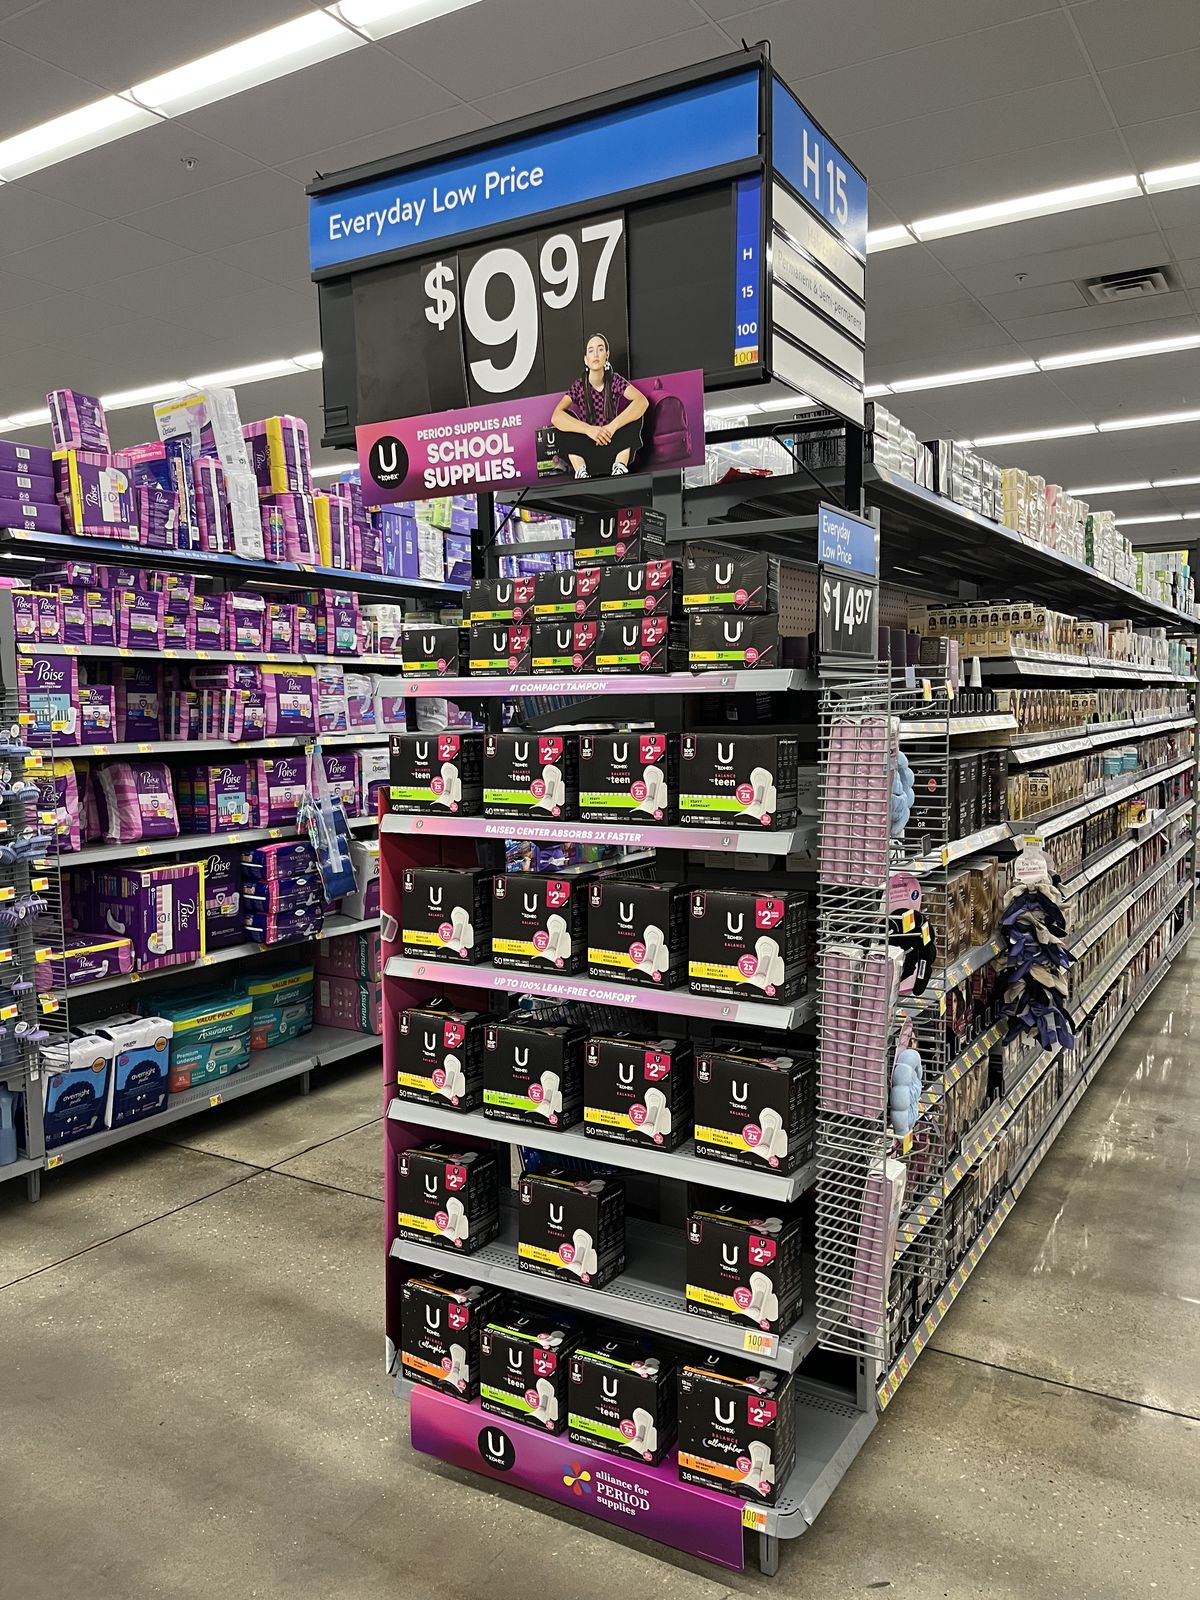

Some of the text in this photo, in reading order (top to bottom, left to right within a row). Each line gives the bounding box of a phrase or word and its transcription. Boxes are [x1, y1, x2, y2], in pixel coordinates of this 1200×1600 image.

[803, 129, 848, 224] H 15
[329, 165, 544, 240] Everyday Low Price
[743, 248, 752, 260] H
[742, 286, 753, 297] 15
[777, 250, 862, 330] Permanent & Semi-permanent
[737, 322, 757, 335] 100
[417, 415, 522, 440] PERIOD SUPPLIES ARE
[378, 443, 397, 472] U
[427, 433, 514, 464] SCHOOL
[424, 458, 521, 489] SUPPLIES.
[600, 518, 613, 538] U
[823, 516, 850, 545] Everyday
[823, 540, 852, 565] Low Price
[628, 570, 641, 591] U
[716, 563, 732, 584] U
[497, 584, 510, 603] U
[560, 576, 573, 595] U
[15, 596, 32, 609] Poise
[39, 598, 56, 611] Poise
[557, 629, 569, 648] U
[623, 626, 636, 646] U
[724, 621, 741, 642] U
[423, 636, 434, 654] U
[494, 633, 506, 651] U
[34, 660, 65, 680] Poise
[287, 678, 302, 691] Poise
[520, 683, 565, 692] COMPACT
[566, 682, 607, 690] TAMPON
[416, 741, 428, 759] U
[515, 742, 529, 761] U
[613, 742, 629, 762] U
[718, 742, 734, 763] U
[276, 761, 297, 777] Poise
[327, 758, 346, 773] Poise
[140, 771, 160, 784] Poise
[221, 768, 241, 784] Poise
[513, 774, 530, 782] teen
[611, 775, 630, 784] teen
[714, 777, 735, 786] teen
[582, 812, 590, 820] 40
[681, 815, 690, 823] 40
[485, 825, 641, 841] RAISED CENTER ABSORBS 2X FASTER
[207, 855, 231, 872] Poise
[430, 886, 442, 905] U
[524, 893, 538, 912] U
[180, 898, 195, 928] Poise
[620, 902, 634, 922] U
[758, 910, 771, 925] $2
[727, 912, 744, 933] U
[494, 957, 502, 965] 50
[590, 968, 599, 976] 50
[272, 981, 287, 989] VALUE
[495, 977, 637, 1002] UP TO 100% LEAK-FREE COMFORT
[691, 982, 700, 991] 50
[360, 985, 368, 1027] Assurance
[197, 1010, 234, 1023] VALUE PACK
[198, 1025, 233, 1040] Assurance
[425, 1032, 436, 1050] U
[176, 1050, 198, 1058] Premium
[176, 1055, 202, 1064] underpads
[515, 1046, 529, 1066] U
[131, 1068, 156, 1080] overnight
[619, 1063, 634, 1083] U
[63, 1089, 90, 1102] overnight
[732, 1080, 748, 1102] U
[586, 1127, 595, 1135] 50
[697, 1146, 706, 1154] 50
[425, 1174, 438, 1193] U
[550, 1203, 564, 1223] U
[722, 1243, 739, 1265] U
[751, 1247, 763, 1263] $2
[520, 1261, 528, 1269] 50
[426, 1304, 441, 1328] U
[688, 1305, 698, 1314] 50
[509, 1347, 522, 1368] U
[508, 1378, 525, 1389] teen
[603, 1376, 619, 1397] U
[600, 1408, 619, 1419] teen
[715, 1397, 736, 1424] U
[751, 1407, 763, 1423] $2
[488, 1431, 504, 1457] U
[570, 1433, 580, 1441] 40
[596, 1471, 649, 1497] alliance for
[682, 1472, 692, 1481] 38
[597, 1482, 650, 1511] PERIOD
[597, 1495, 636, 1517] supplies
